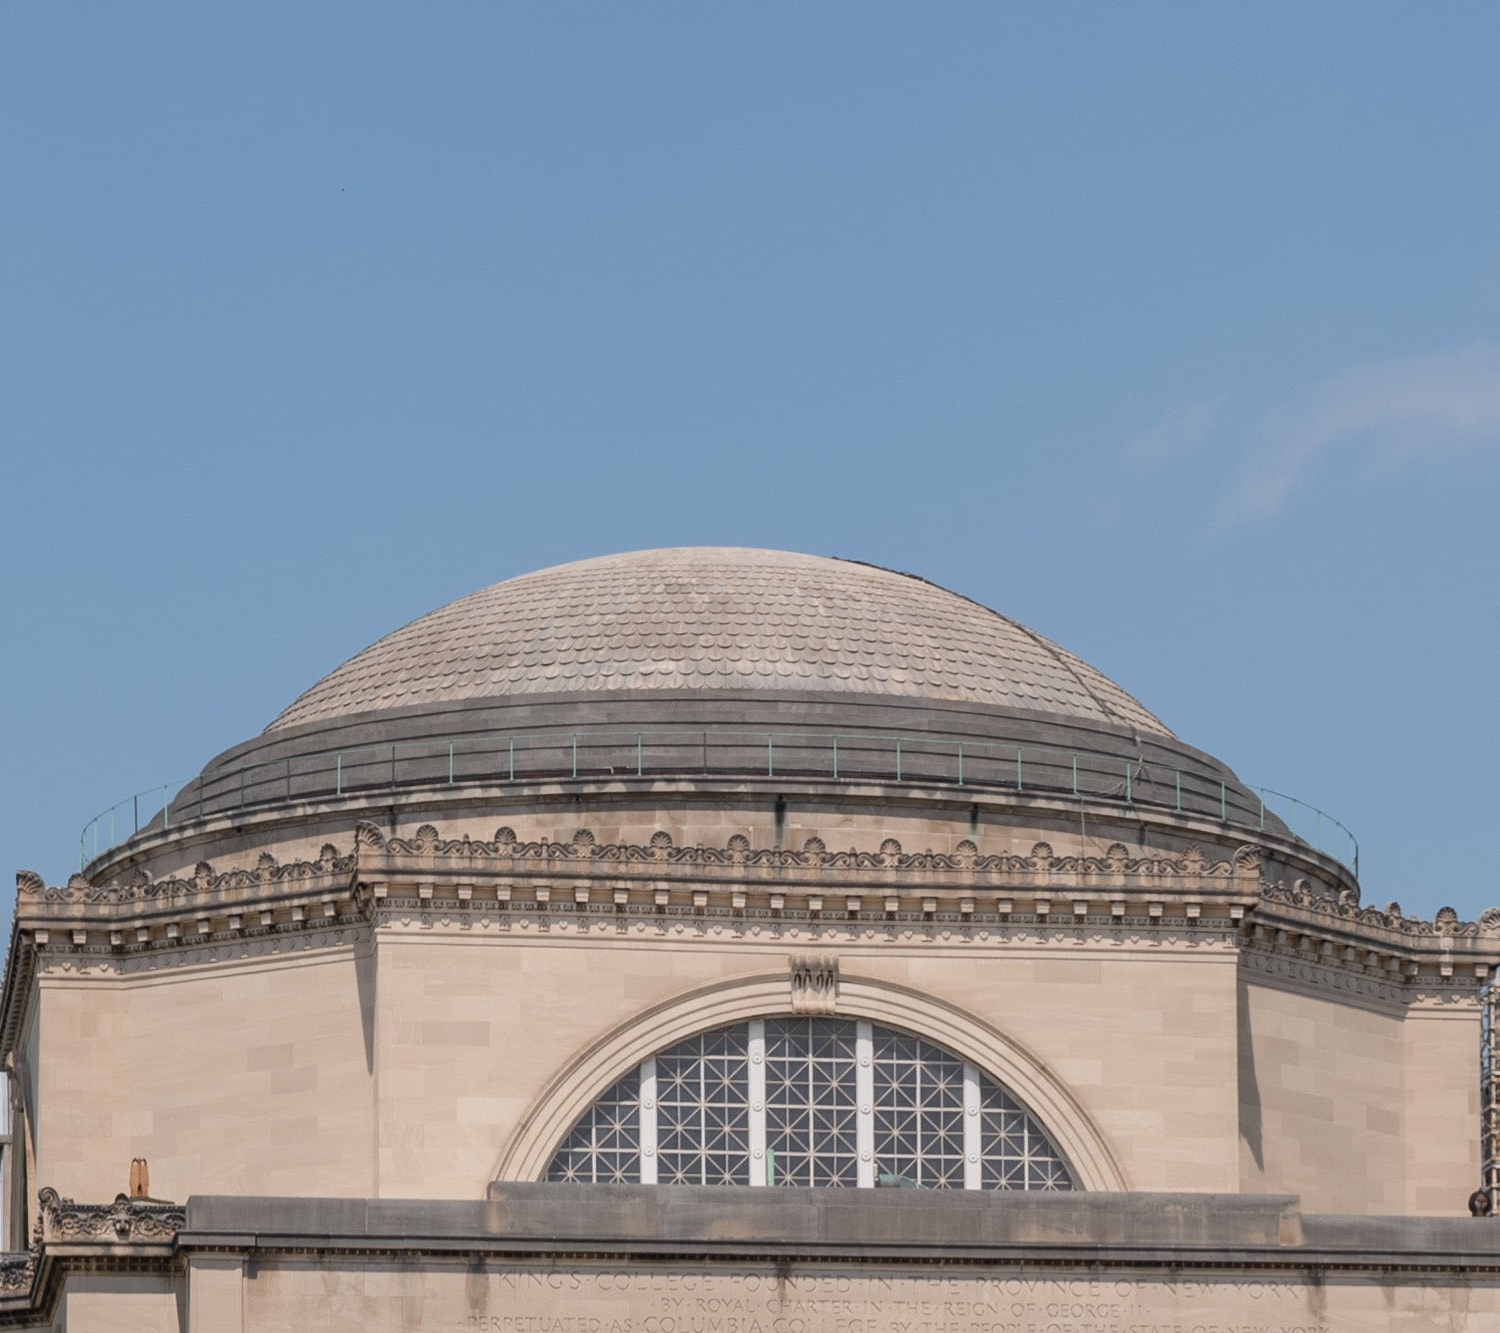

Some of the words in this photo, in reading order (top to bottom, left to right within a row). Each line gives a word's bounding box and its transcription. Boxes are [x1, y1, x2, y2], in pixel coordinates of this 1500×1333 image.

[596, 1271, 714, 1292] COLLEGE
[730, 1273, 852, 1293] FOUNDED
[869, 1275, 893, 1292] IN
[908, 1276, 960, 1295] THE
[976, 1276, 1100, 1298] PROVINCE
[1115, 1278, 1147, 1297] OF
[1164, 1279, 1219, 1298] NEW
[1234, 1279, 1301, 1300] YORK
[661, 1298, 683, 1313] BY
[696, 1298, 756, 1313] ROYAL
[766, 1299, 852, 1315] CHARTER
[864, 1300, 882, 1314] IN
[894, 1301, 931, 1315] THE
[944, 1302, 998, 1317] REIGN
[1011, 1303, 1035, 1317] OF
[1046, 1303, 1120, 1318] GEORGE
[467, 1316, 600, 1333] PERPETUATED
[610, 1318, 634, 1333] AS
